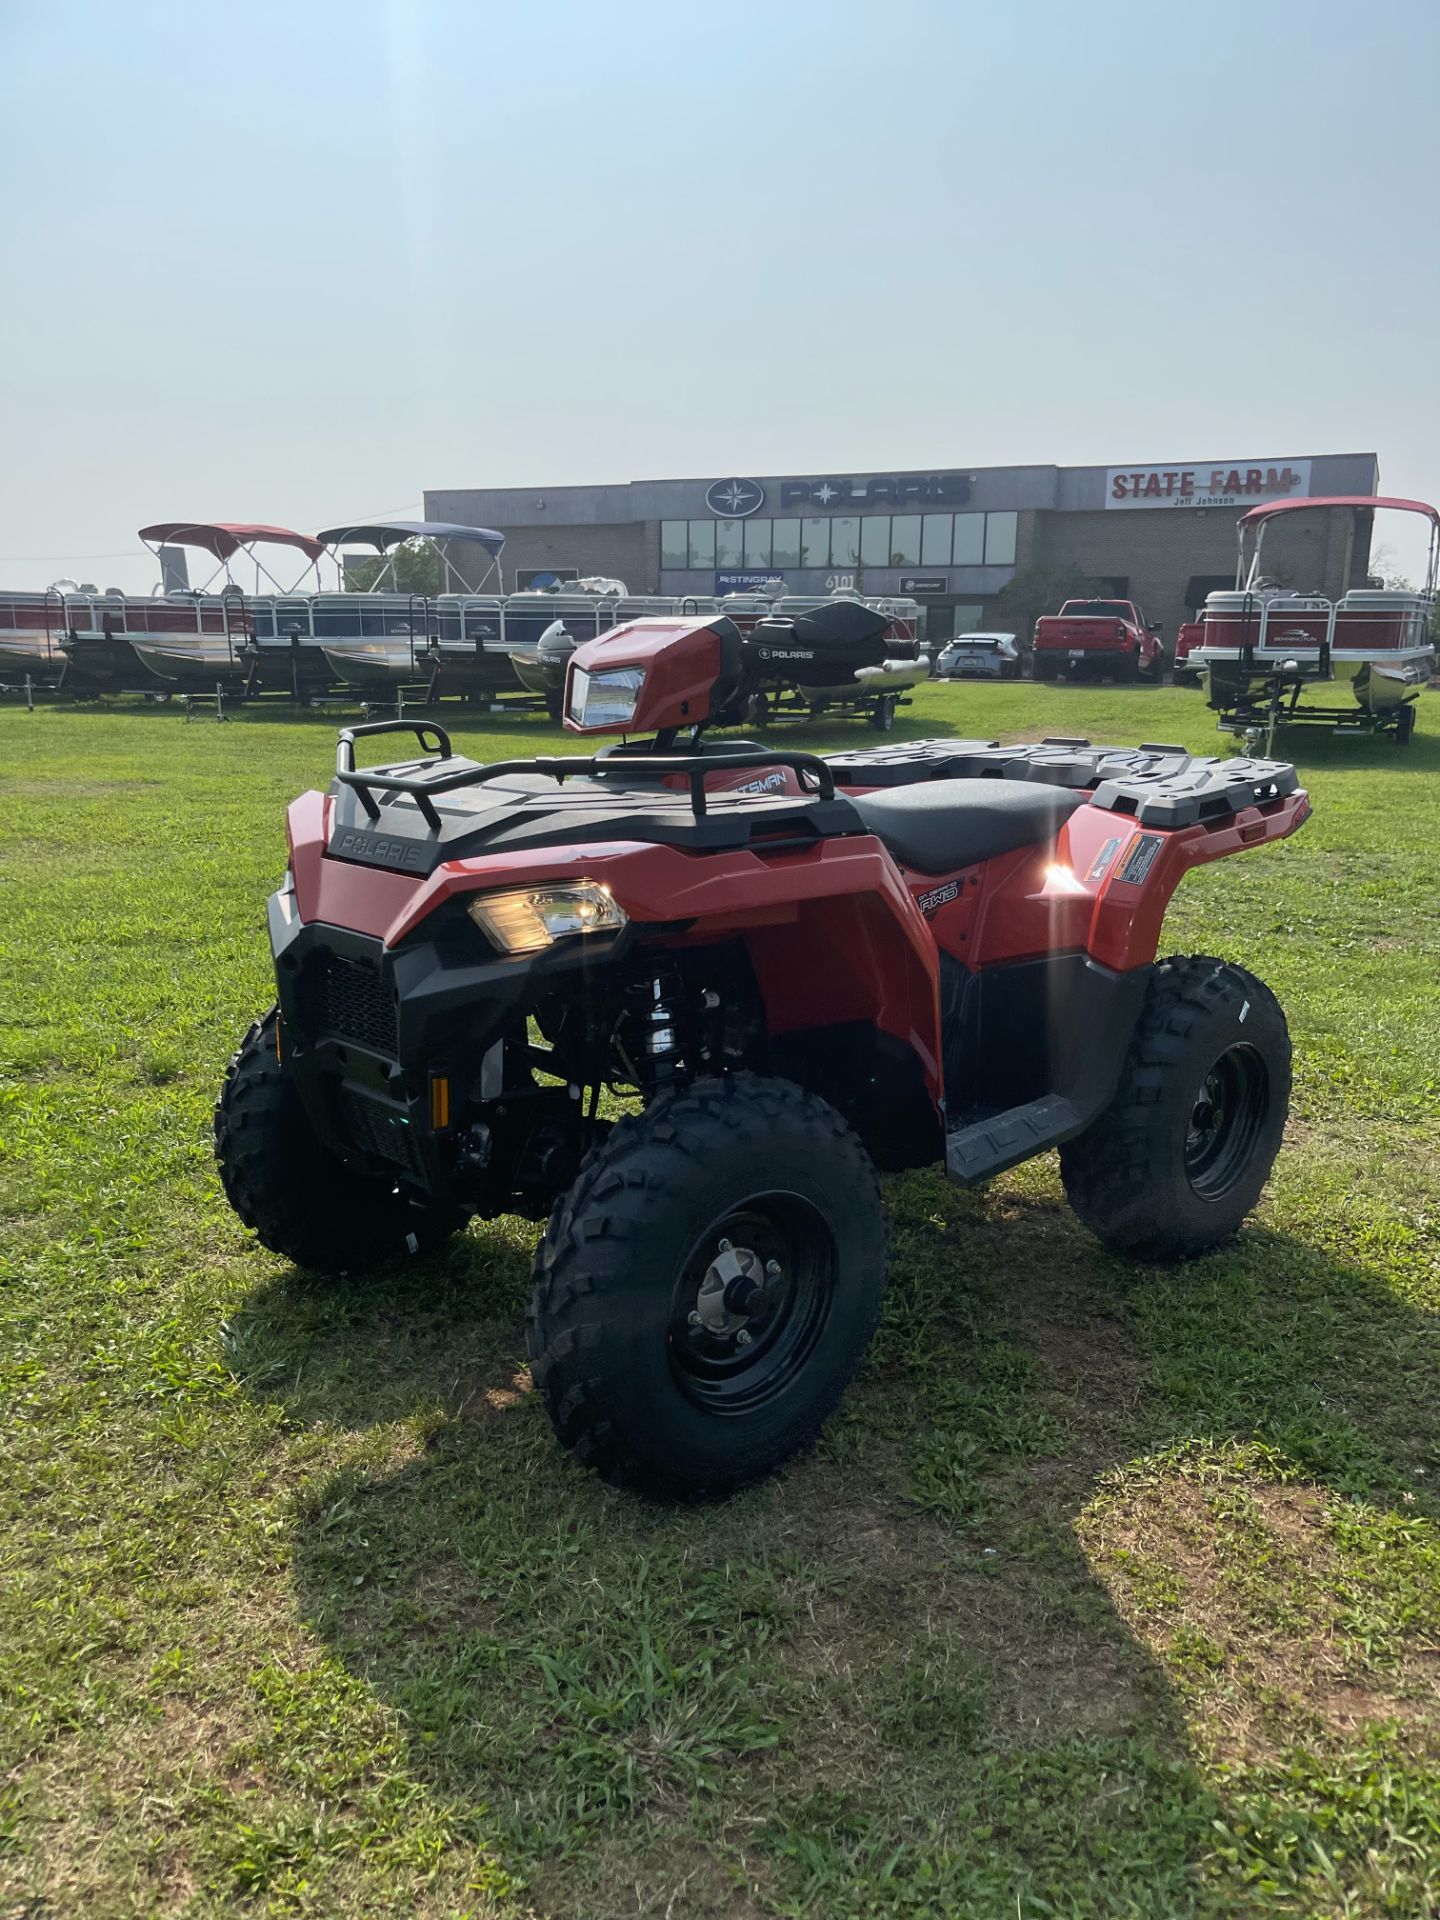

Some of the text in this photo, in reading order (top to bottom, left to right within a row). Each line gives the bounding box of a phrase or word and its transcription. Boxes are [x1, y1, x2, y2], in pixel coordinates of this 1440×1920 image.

[781, 475, 970, 509] POLARIS
[1112, 472, 1195, 499] STATE
[1174, 497, 1235, 506] Jeff Johnson
[729, 575, 782, 584] STINGRAY
[825, 575, 854, 589] 6101
[772, 650, 814, 659] POLARIS
[735, 770, 787, 793] TSMAN
[340, 833, 421, 865] POLARIS
[920, 887, 958, 913] AWD
